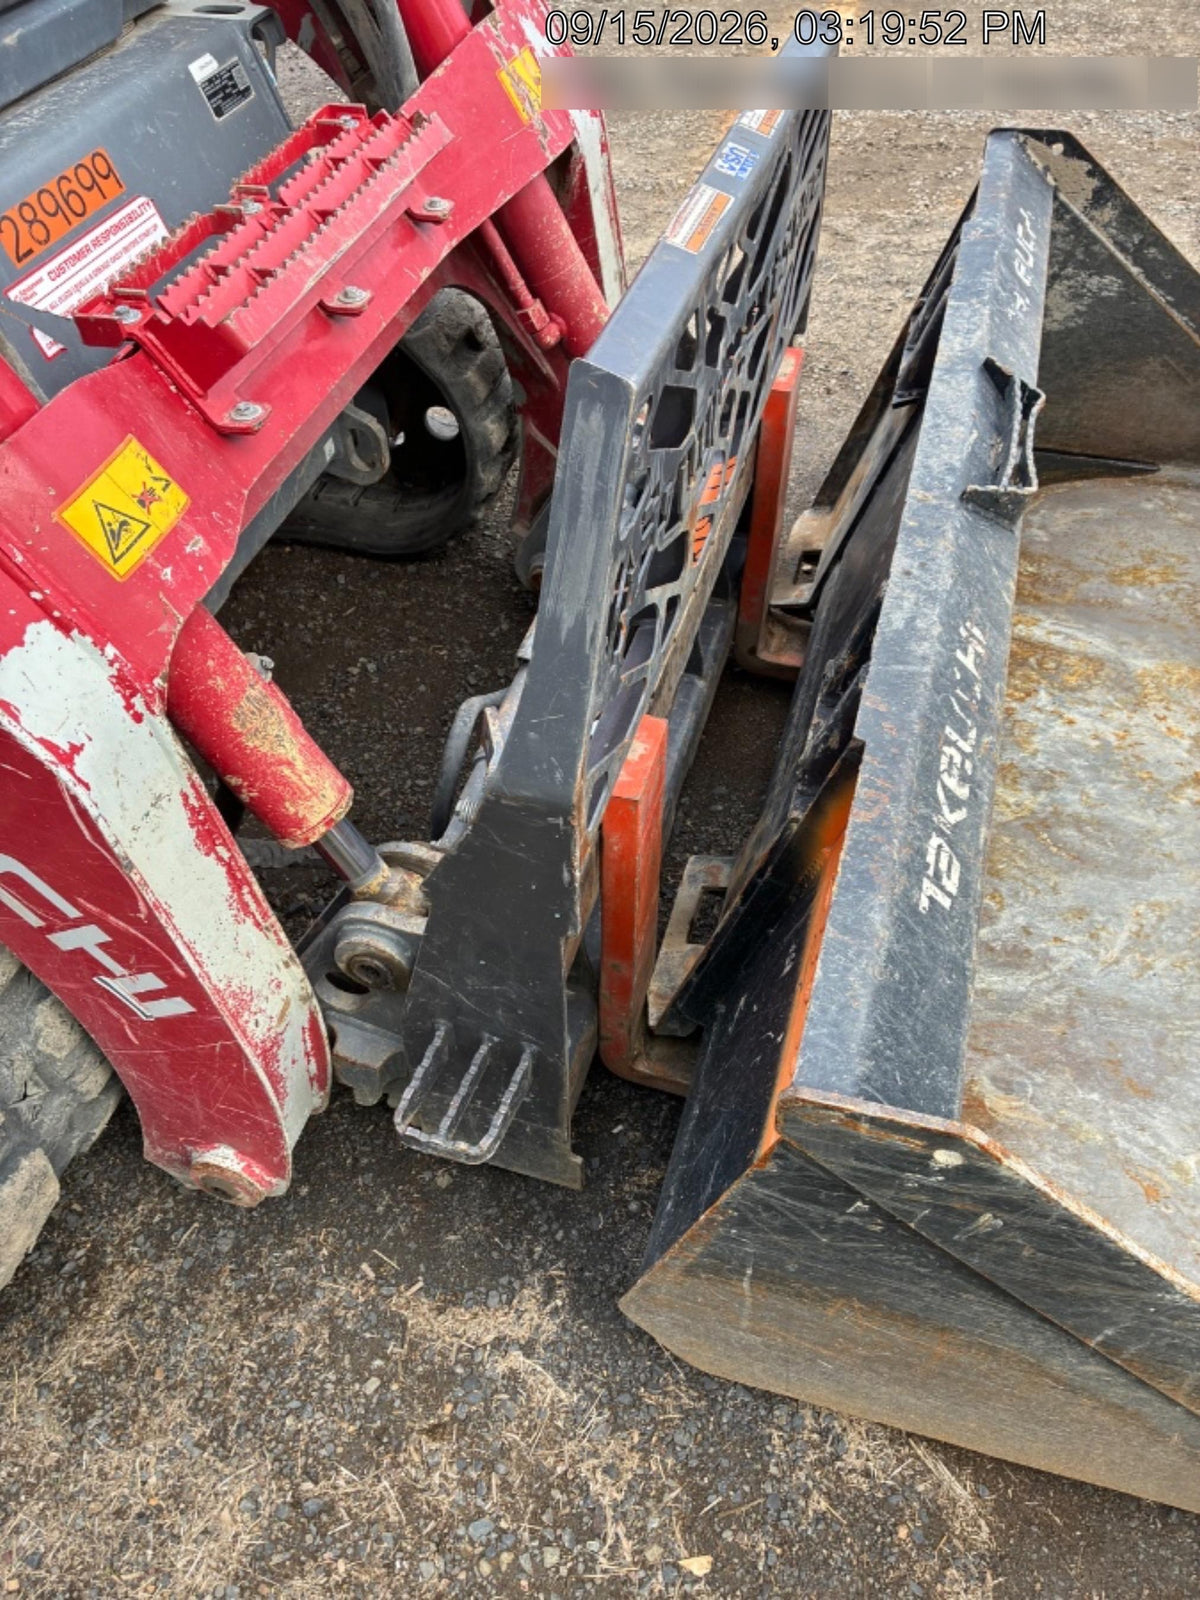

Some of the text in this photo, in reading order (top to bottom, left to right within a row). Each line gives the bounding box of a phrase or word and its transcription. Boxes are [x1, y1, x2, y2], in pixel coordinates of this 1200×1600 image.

[0, 151, 124, 263] 289699
[47, 200, 152, 281] CUSTOMER RESPONSIBILITY
